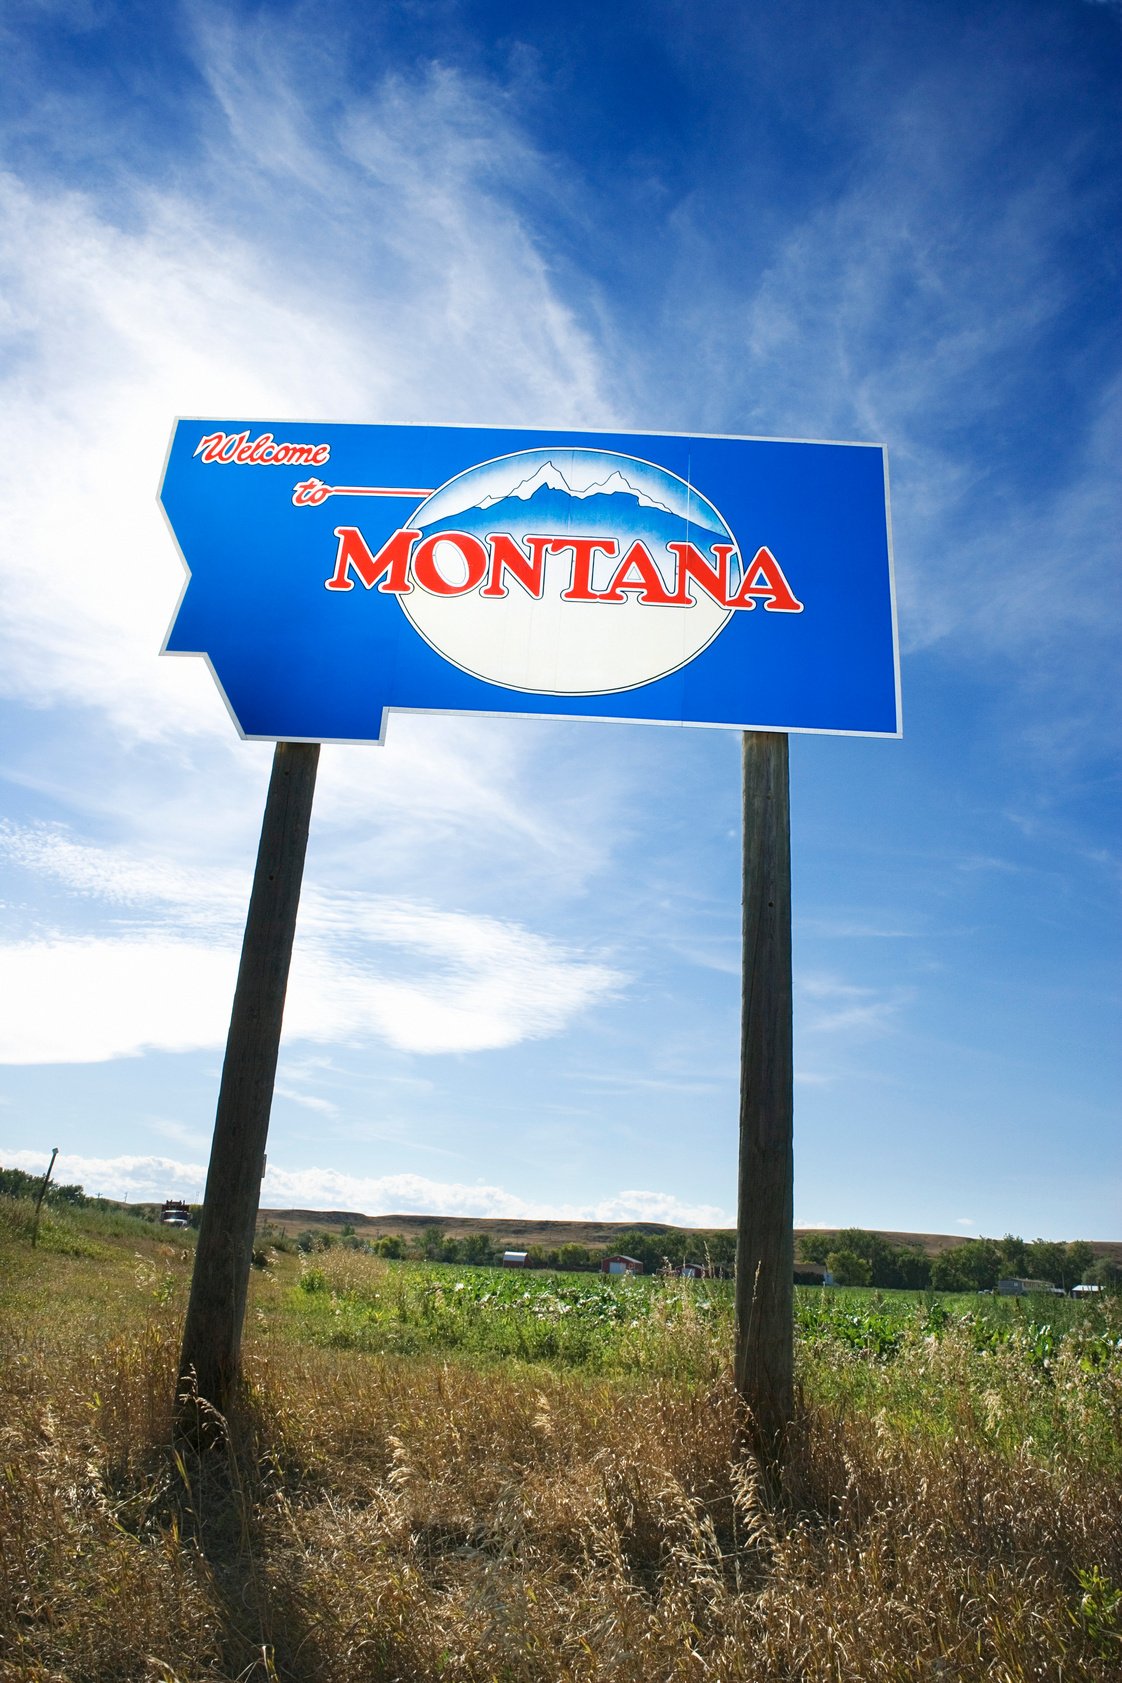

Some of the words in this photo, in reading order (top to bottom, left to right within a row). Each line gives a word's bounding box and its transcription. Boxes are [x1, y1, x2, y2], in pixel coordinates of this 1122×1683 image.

[194, 431, 330, 465] Welcome
[293, 478, 331, 506] to
[325, 527, 804, 612] MONTANA
